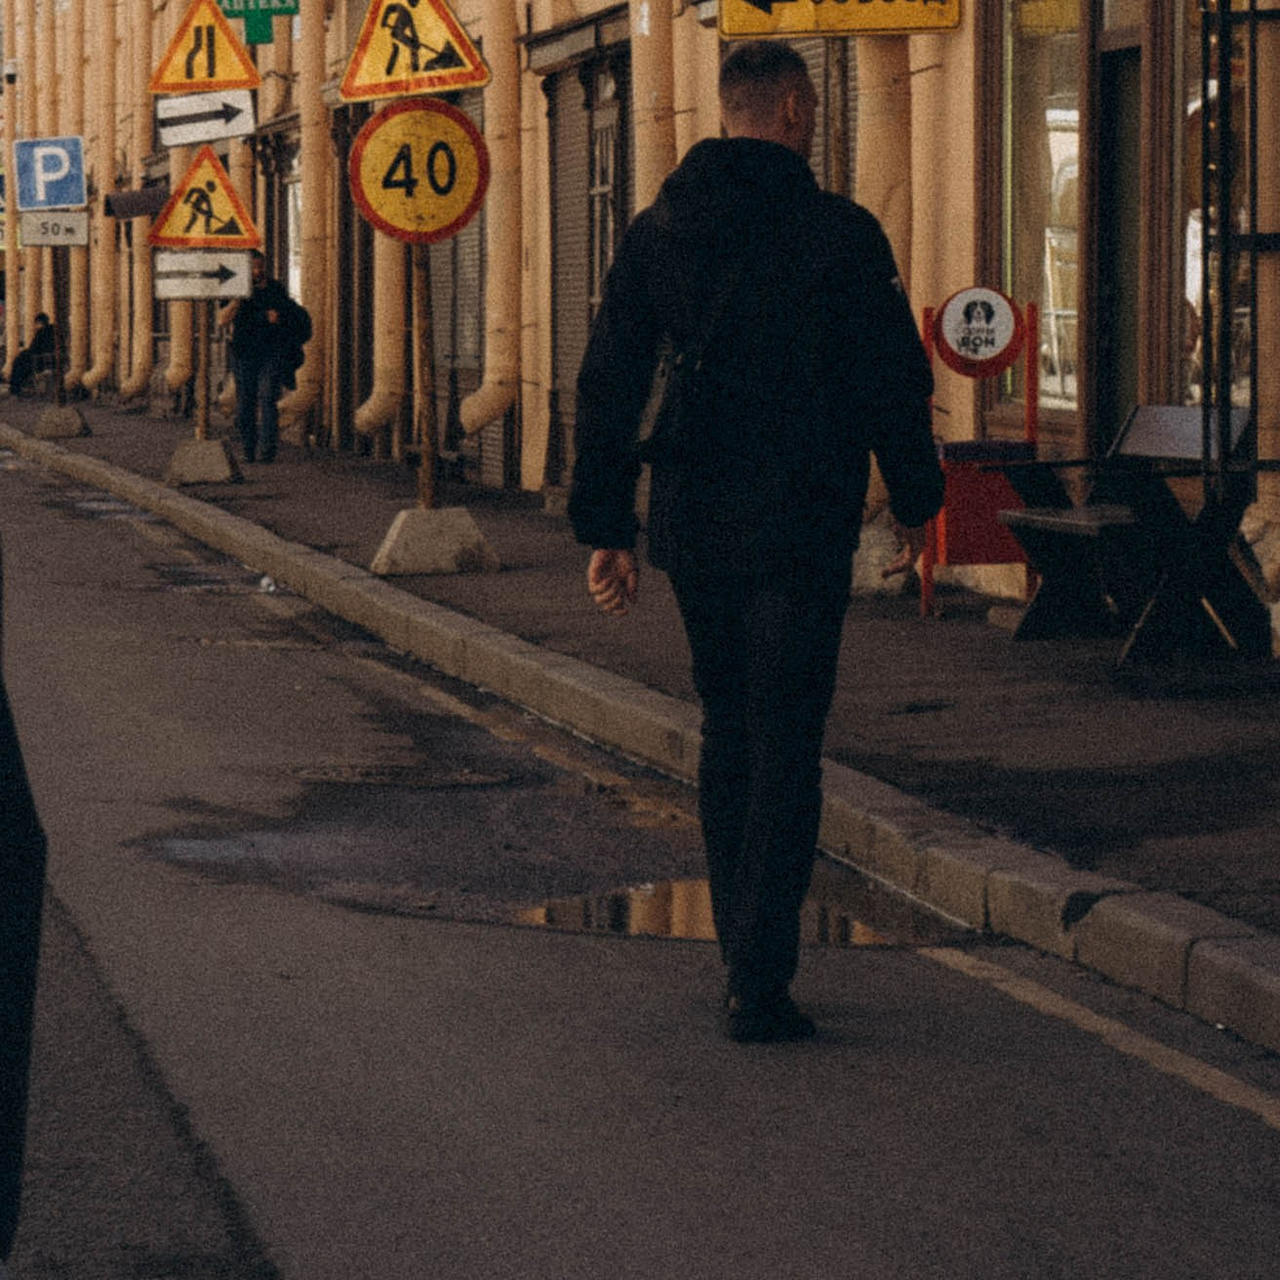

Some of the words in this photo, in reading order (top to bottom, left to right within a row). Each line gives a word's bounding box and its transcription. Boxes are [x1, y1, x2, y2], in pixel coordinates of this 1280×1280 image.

[33, 146, 70, 201] P
[382, 141, 457, 197] 40
[40, 222, 60, 235] 50
